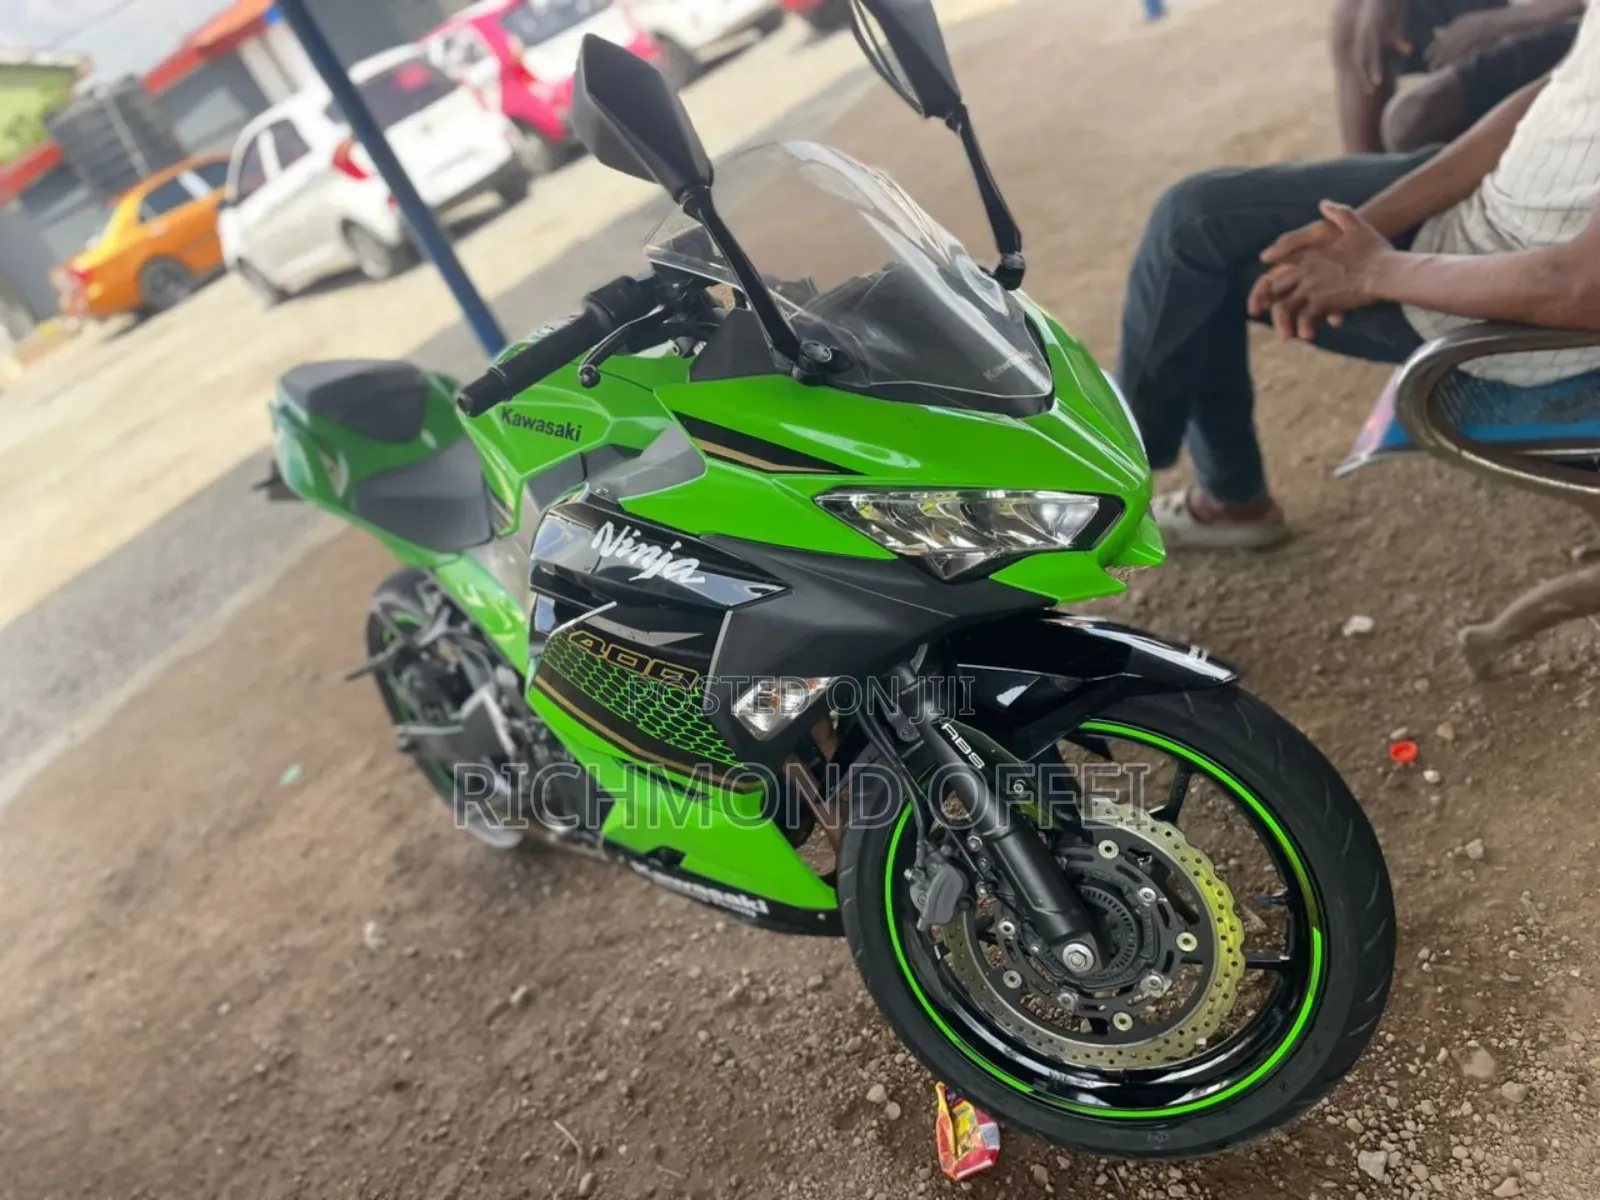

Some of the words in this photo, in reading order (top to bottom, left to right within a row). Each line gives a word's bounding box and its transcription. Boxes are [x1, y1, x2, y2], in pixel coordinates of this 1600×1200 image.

[501, 406, 583, 442] Kawasaki
[591, 521, 706, 584] Ninja
[568, 630, 700, 691] 400
[941, 723, 985, 769] ABS
